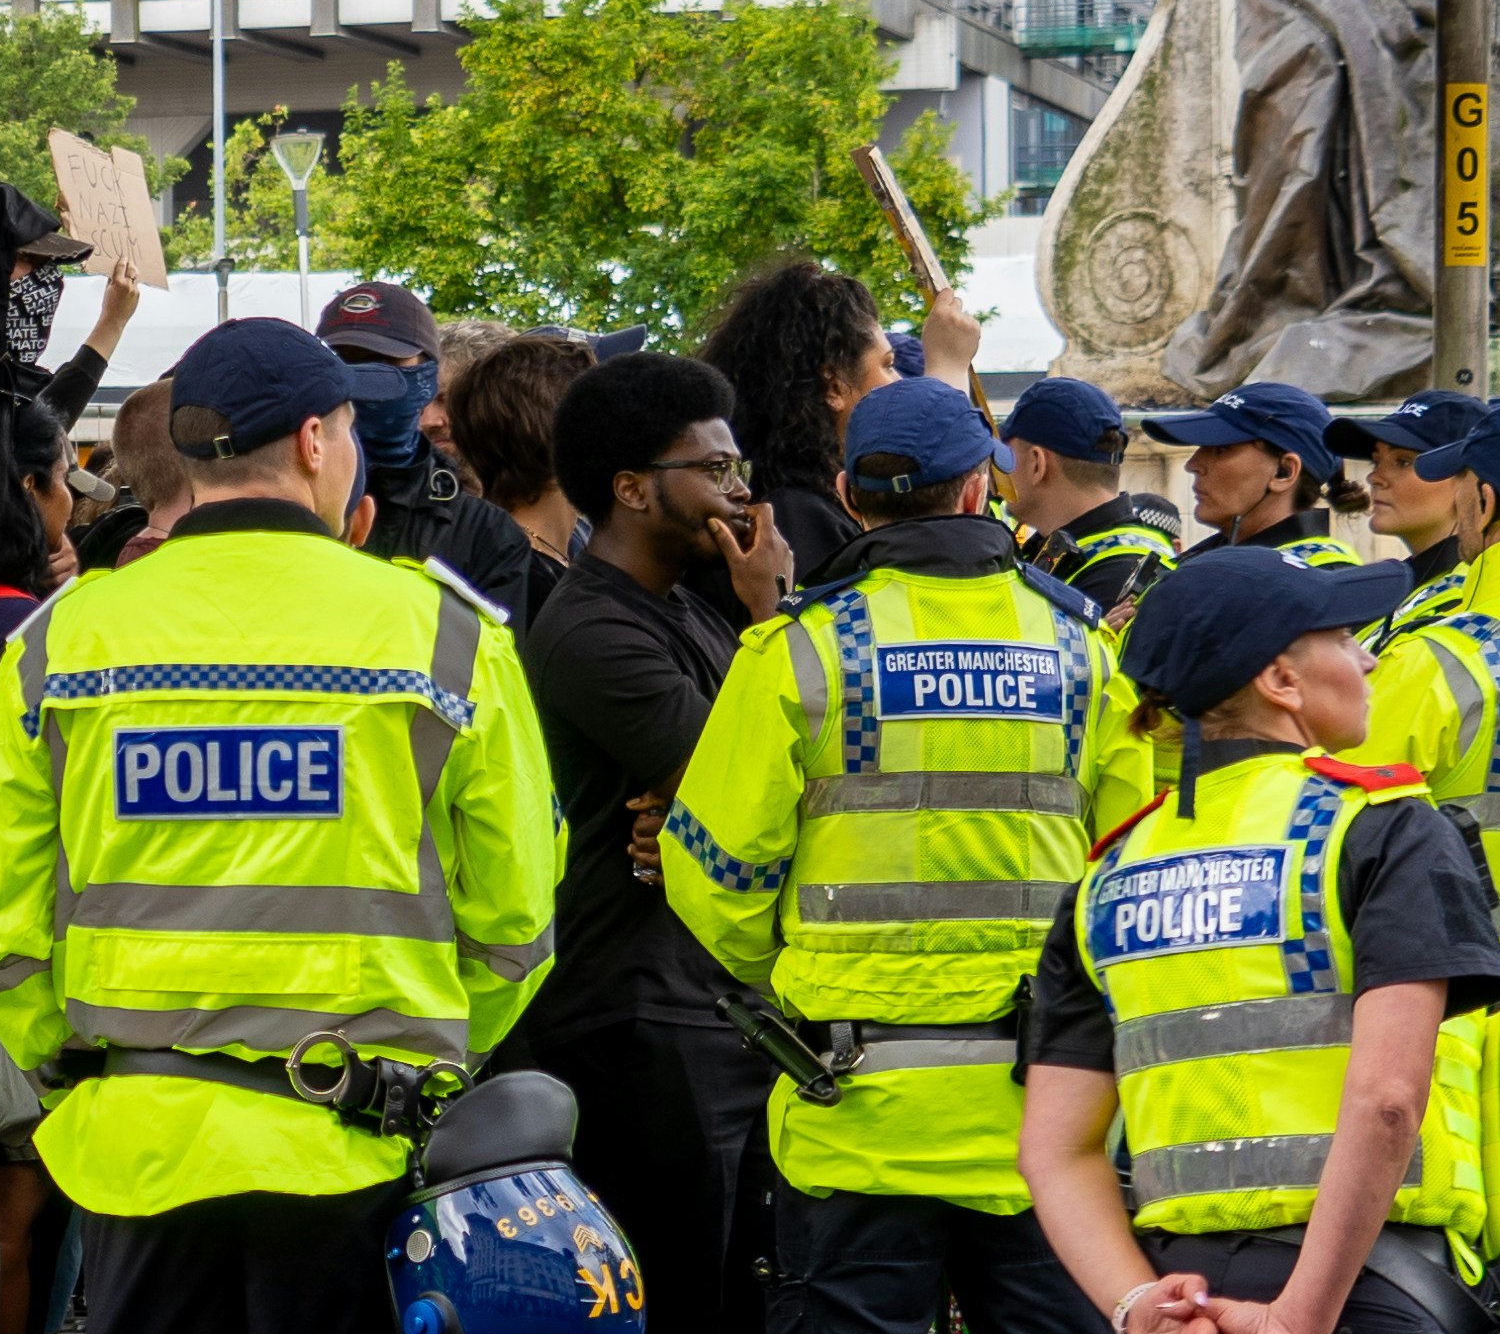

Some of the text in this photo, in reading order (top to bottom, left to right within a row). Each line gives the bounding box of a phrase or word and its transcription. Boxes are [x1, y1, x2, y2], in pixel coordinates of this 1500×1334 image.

[67, 154, 126, 198] FUCK
[79, 193, 132, 229] NAZI
[91, 229, 143, 265] SCUM
[22, 283, 58, 304] STILL
[886, 651, 1056, 675] GREATER MANCHESTER
[914, 673, 1037, 709] POLICE
[125, 740, 330, 803] POLICE
[1100, 856, 1276, 904] GREATER MANCHESTER
[1114, 887, 1244, 947] POLICE
[577, 1258, 643, 1318] CK
